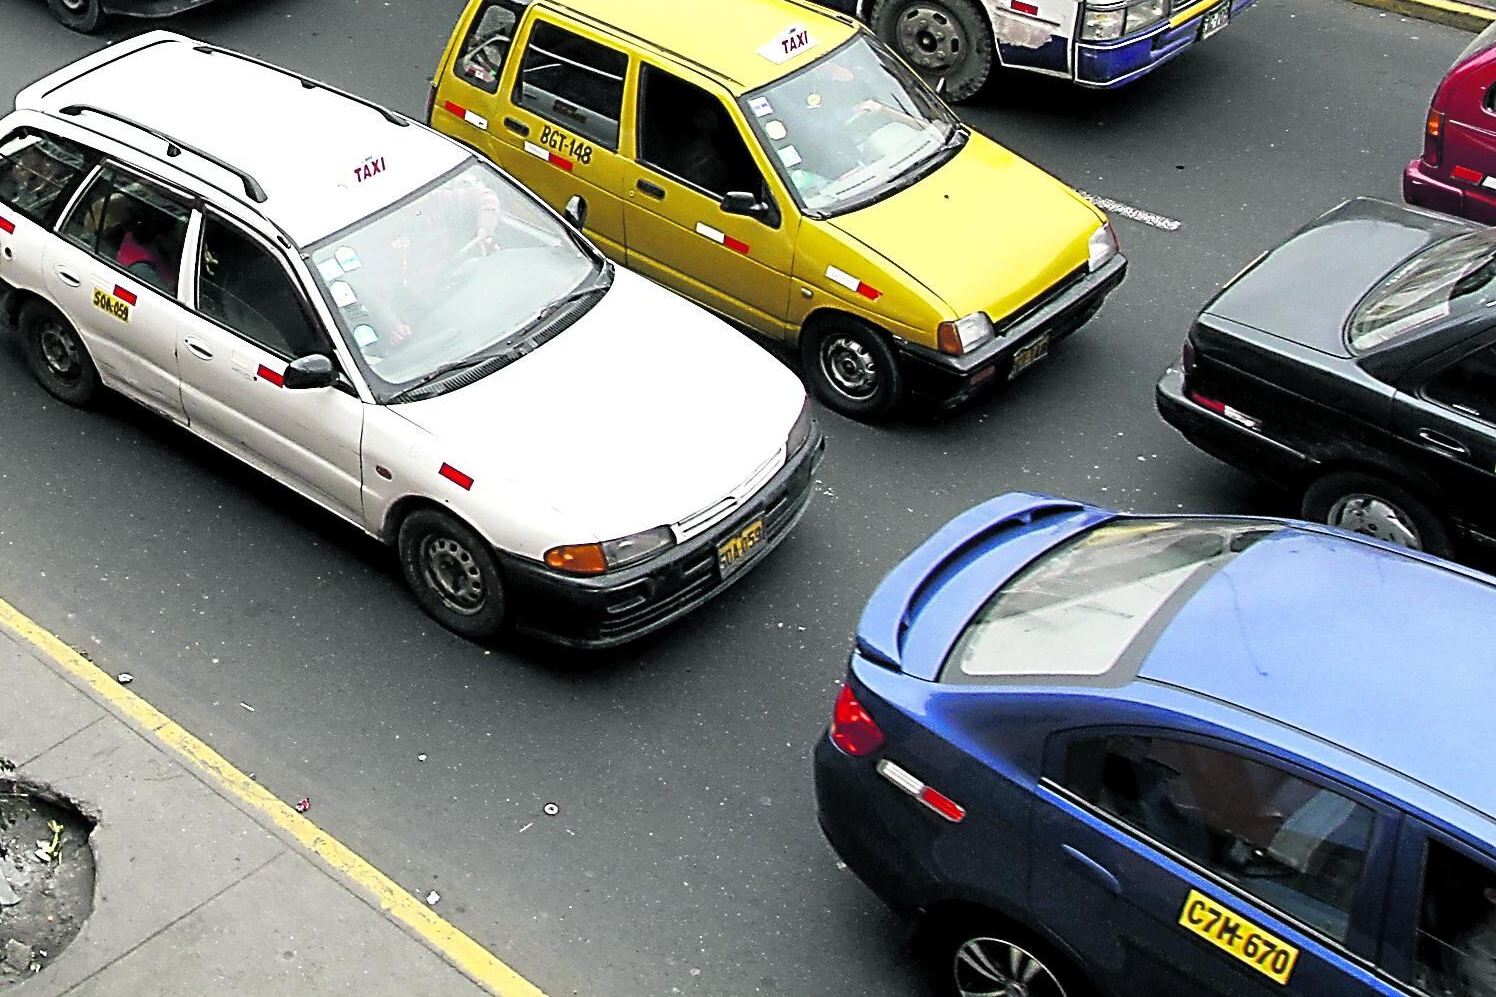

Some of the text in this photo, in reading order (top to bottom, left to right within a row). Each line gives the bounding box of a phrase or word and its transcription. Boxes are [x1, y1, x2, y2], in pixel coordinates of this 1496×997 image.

[781, 30, 809, 54] TAXI
[540, 124, 593, 165] BGT-148
[353, 156, 387, 183] TAXI
[1186, 899, 1291, 976] C7M-670
